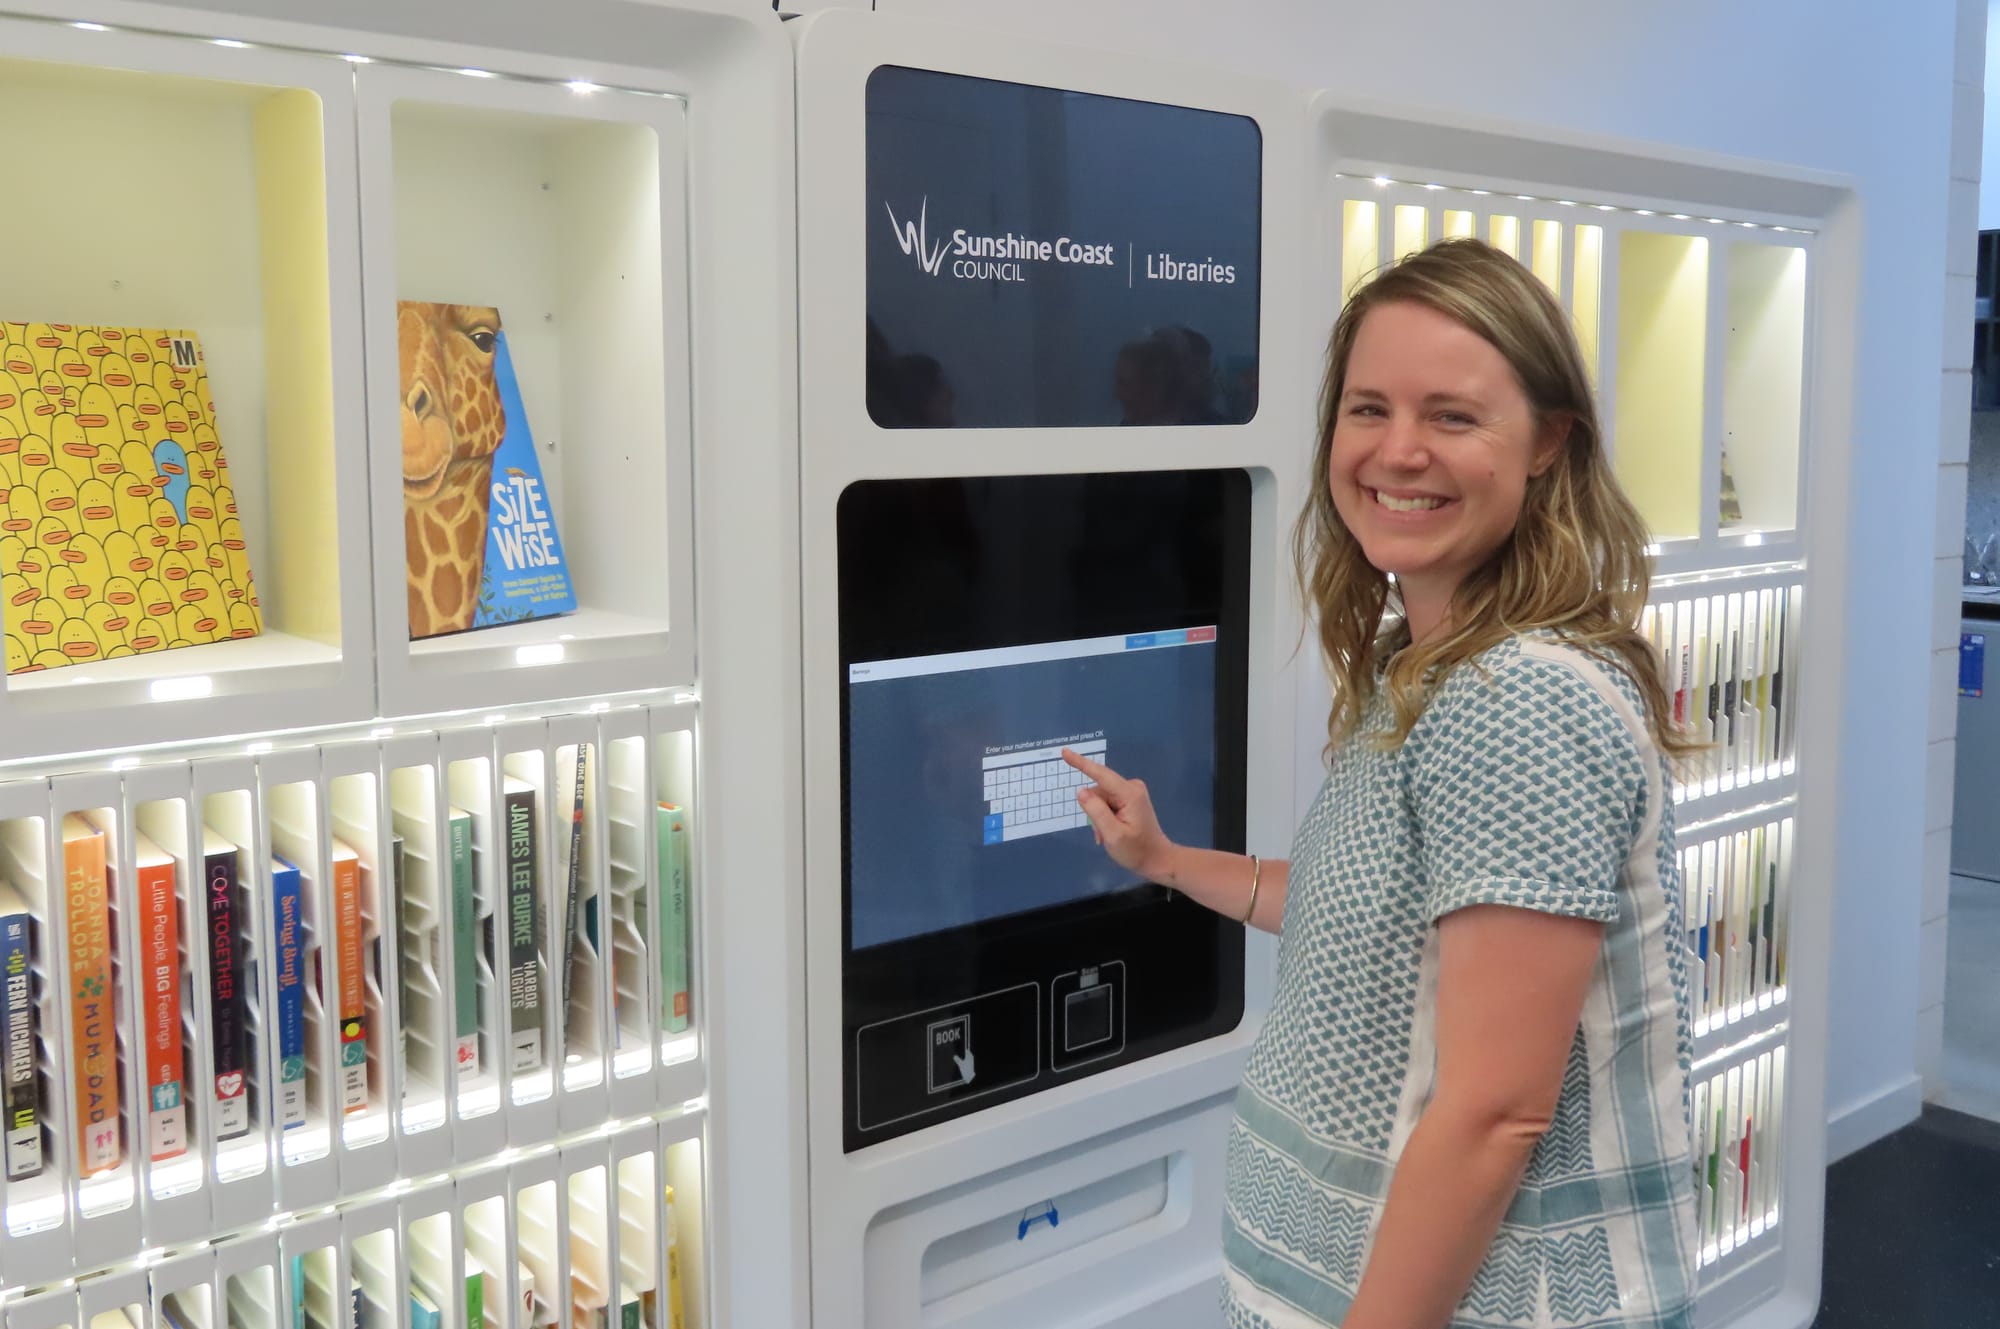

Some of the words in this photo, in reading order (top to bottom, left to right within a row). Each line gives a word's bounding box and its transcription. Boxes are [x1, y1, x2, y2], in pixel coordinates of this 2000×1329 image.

[953, 229, 1052, 261] Sunshine
[1055, 237, 1114, 266] Coast
[1147, 253, 1236, 284] Libraries
[953, 260, 1025, 282] COUNCIL
[174, 339, 198, 367] M
[985, 745, 1001, 754] Enter
[1001, 744, 1014, 752] your
[1014, 741, 1035, 749] number
[1042, 737, 1068, 745] username
[1069, 734, 1080, 742] and
[1080, 733, 1095, 741] press
[1095, 730, 1104, 738] OK
[511, 803, 529, 858] JAMES
[151, 879, 167, 913] Little
[211, 864, 230, 912] COME
[343, 872, 353, 888] THE
[513, 861, 531, 891] LEE
[69, 867, 88, 971] TROLLOPE
[87, 875, 103, 960] JOANNA
[280, 895, 297, 945] Saving
[343, 891, 355, 926] WONDER
[514, 894, 531, 946] BURKE
[152, 914, 170, 964] People,
[214, 911, 233, 1000] TOGETHER
[7, 975, 28, 1011] FERN
[157, 966, 170, 992] BIG
[511, 967, 525, 1009] LIGHTS
[524, 960, 537, 1009] HARBOR
[84, 1003, 102, 1058] MUM
[156, 994, 172, 1050] Feelings
[936, 1027, 961, 1045] BOOK
[10, 1012, 32, 1082] MICHAELS
[89, 1075, 105, 1122] DAD
